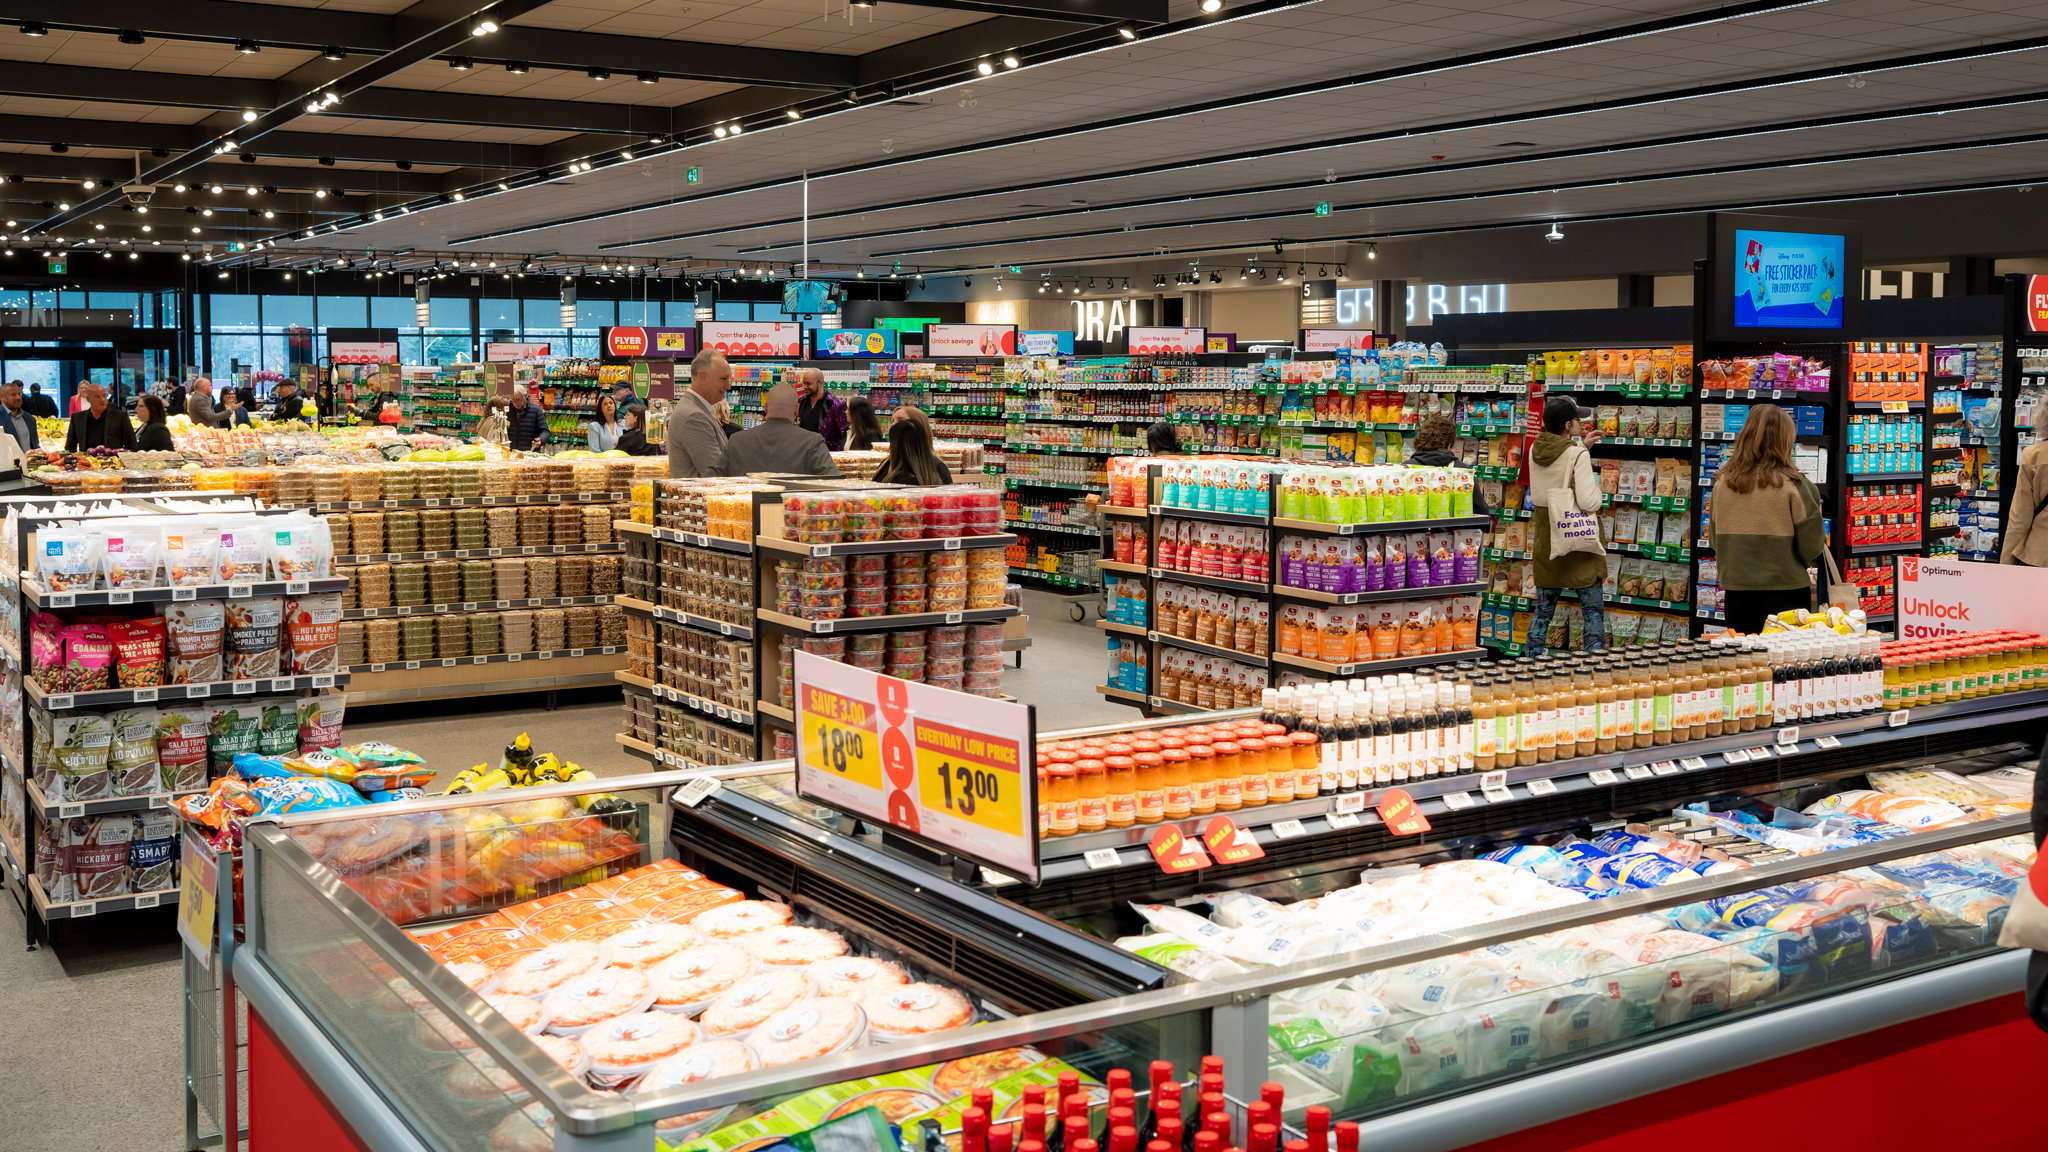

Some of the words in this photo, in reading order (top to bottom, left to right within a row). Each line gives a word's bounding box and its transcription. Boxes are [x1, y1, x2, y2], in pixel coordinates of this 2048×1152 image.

[1765, 264, 1779, 281] FREE
[1780, 264, 1803, 280] STICKER
[1803, 264, 1818, 280] PACK
[1304, 284, 1310, 297] 5
[1779, 283, 1790, 293] EVERY
[560, 291, 564, 303] 2
[694, 294, 699, 306] 3
[978, 302, 1015, 322] CUSTOMER
[614, 336, 641, 345] FLYER
[1922, 566, 1962, 576] Optimum
[1904, 597, 1970, 621] Unlock
[119, 644, 137, 652] PEAS
[810, 689, 837, 718] SAVE
[840, 696, 865, 726] 3.00
[220, 736, 238, 744] SALAD
[917, 726, 962, 751] EVERYDAY
[964, 738, 984, 758] LOW
[987, 743, 1016, 764] PRICE
[1385, 798, 1409, 820] SALE
[1209, 824, 1232, 848] SALE
[1155, 832, 1179, 856] SALE
[76, 854, 111, 863] HICKORY
[139, 846, 170, 858] SMART
[1225, 849, 1250, 860] SALE
[191, 851, 205, 882] SALE
[1171, 858, 1198, 869] SALE
[1692, 992, 1714, 1005] COOKED
[1573, 1017, 1589, 1030] RAW
[1510, 1033, 1529, 1045] RAW
[1440, 1053, 1457, 1069] RAW
